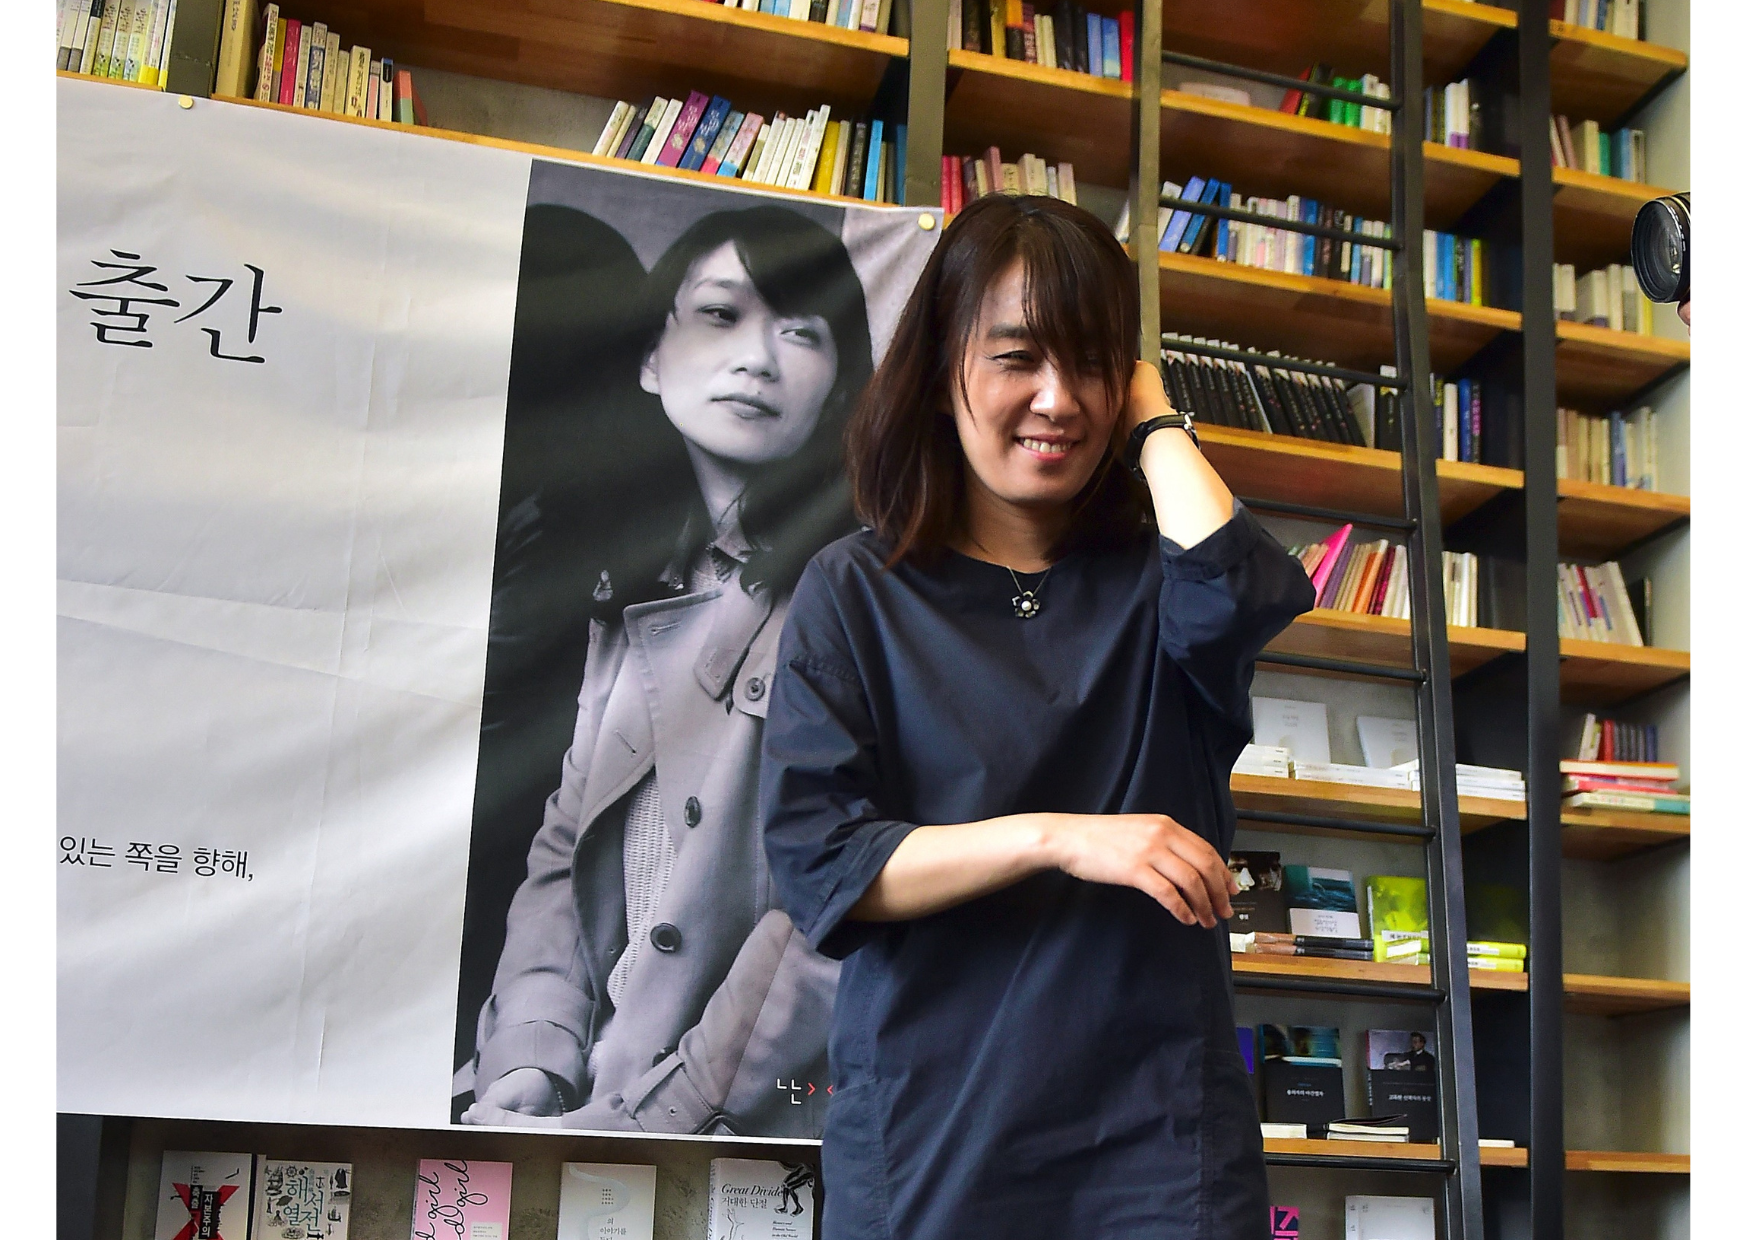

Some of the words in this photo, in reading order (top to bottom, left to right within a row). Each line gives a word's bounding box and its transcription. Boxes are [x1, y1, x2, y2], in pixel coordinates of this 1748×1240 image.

[68, 248, 283, 364] 출간
[59, 835, 116, 868] 있는
[124, 841, 183, 874] 쪽을
[192, 847, 254, 882] 향해,
[721, 1183, 749, 1195] Great
[750, 1184, 783, 1197] Divide
[721, 1196, 748, 1208] 거대한
[750, 1198, 768, 1210] 단절
[202, 1193, 214, 1238] 자본주의
[283, 1203, 321, 1232] 열전
[599, 1226, 627, 1236] 이야기를
